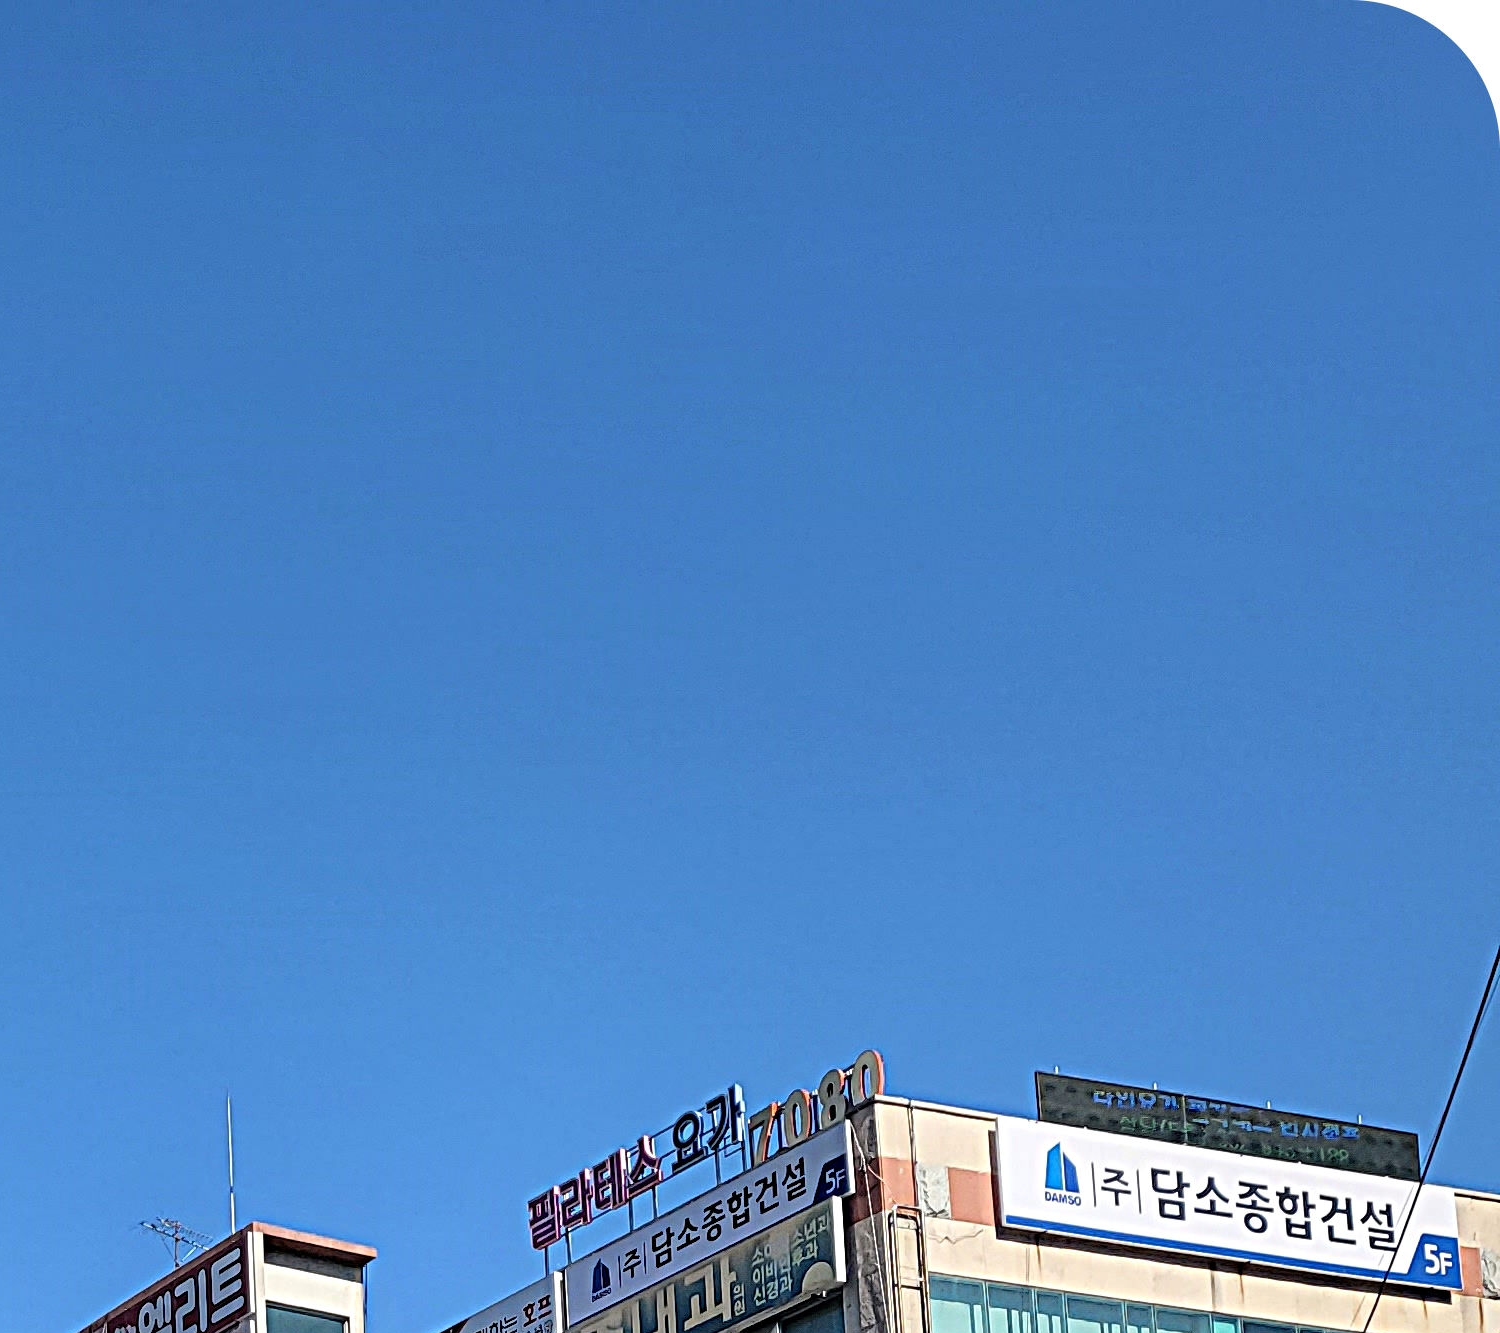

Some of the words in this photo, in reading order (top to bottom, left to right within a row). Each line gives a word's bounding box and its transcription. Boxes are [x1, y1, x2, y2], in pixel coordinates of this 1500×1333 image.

[527, 1133, 664, 1250] 필라테스
[672, 1084, 744, 1174] 요가
[748, 1049, 885, 1169] 7080
[650, 1156, 808, 1269] 담소종합건설
[825, 1164, 847, 1195] 5F
[1043, 1190, 1083, 1207] DAMSO
[1150, 1166, 1398, 1252] 담소종합건설
[1423, 1242, 1454, 1276] 5F
[522, 1294, 552, 1327] 호프
